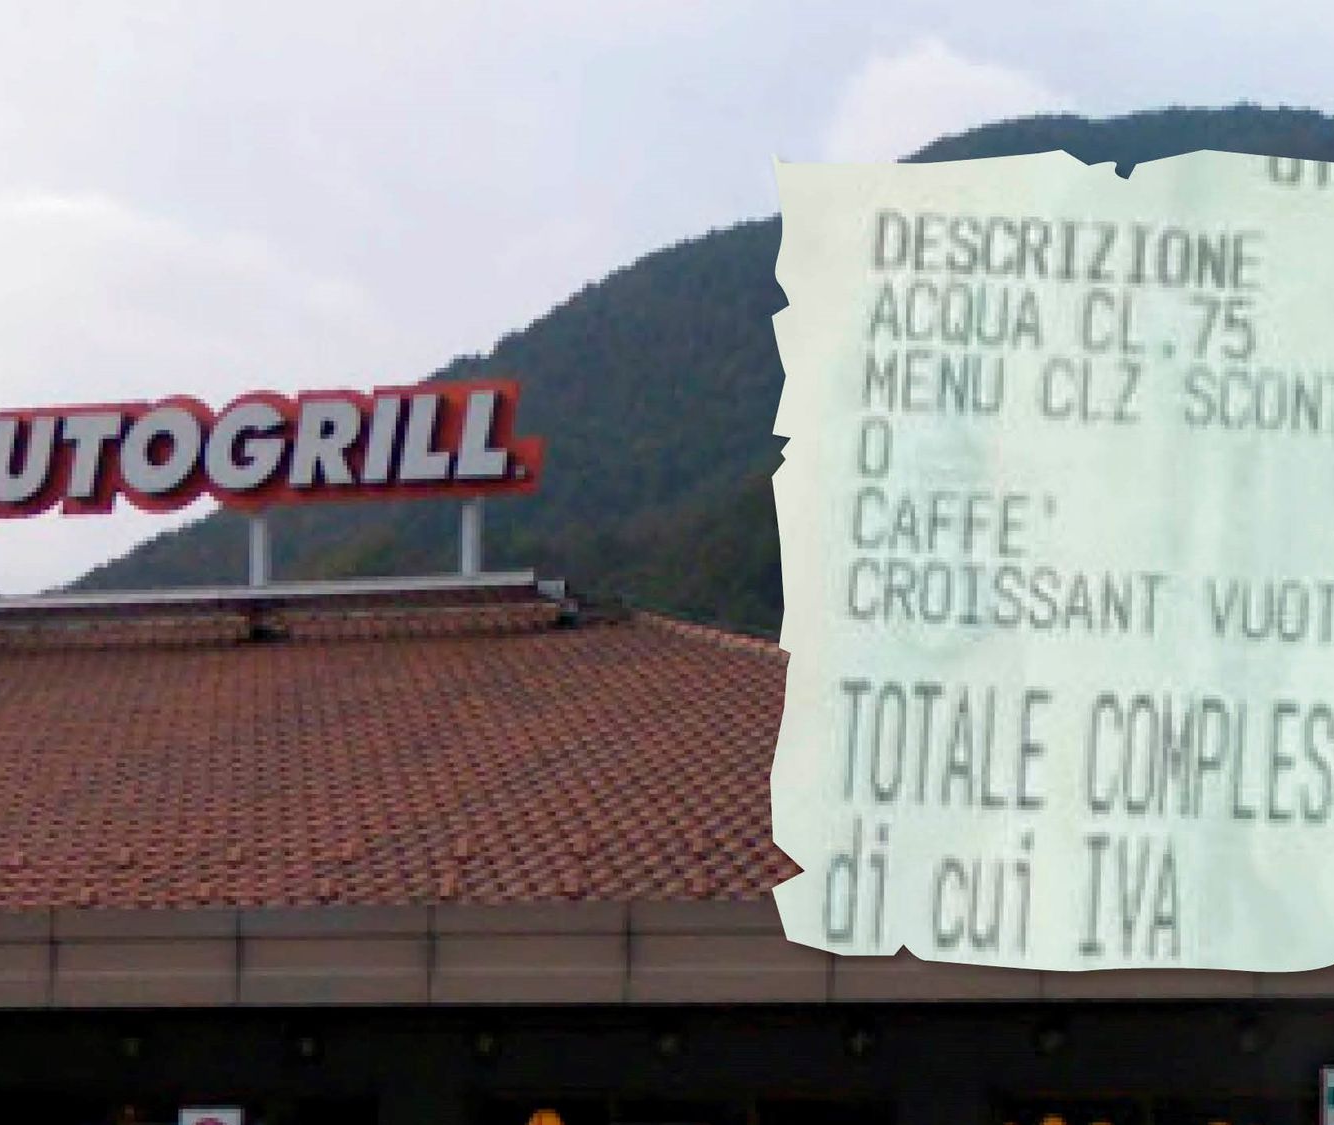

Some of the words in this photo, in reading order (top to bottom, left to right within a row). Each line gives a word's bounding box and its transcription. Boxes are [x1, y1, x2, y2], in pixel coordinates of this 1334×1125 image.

[873, 210, 1264, 291] DESCRIZIONE
[868, 281, 1044, 351] ACQUA
[1082, 289, 1257, 361] CL.75
[865, 350, 1005, 413] MENU
[1041, 358, 1142, 425] CLZ
[851, 487, 1058, 556] CAFFE'
[847, 559, 1166, 636] CROISSANT
[841, 680, 1055, 810] TOTALE
[823, 816, 888, 948] di
[930, 830, 1033, 951] cui
[1079, 835, 1183, 958] IVA
